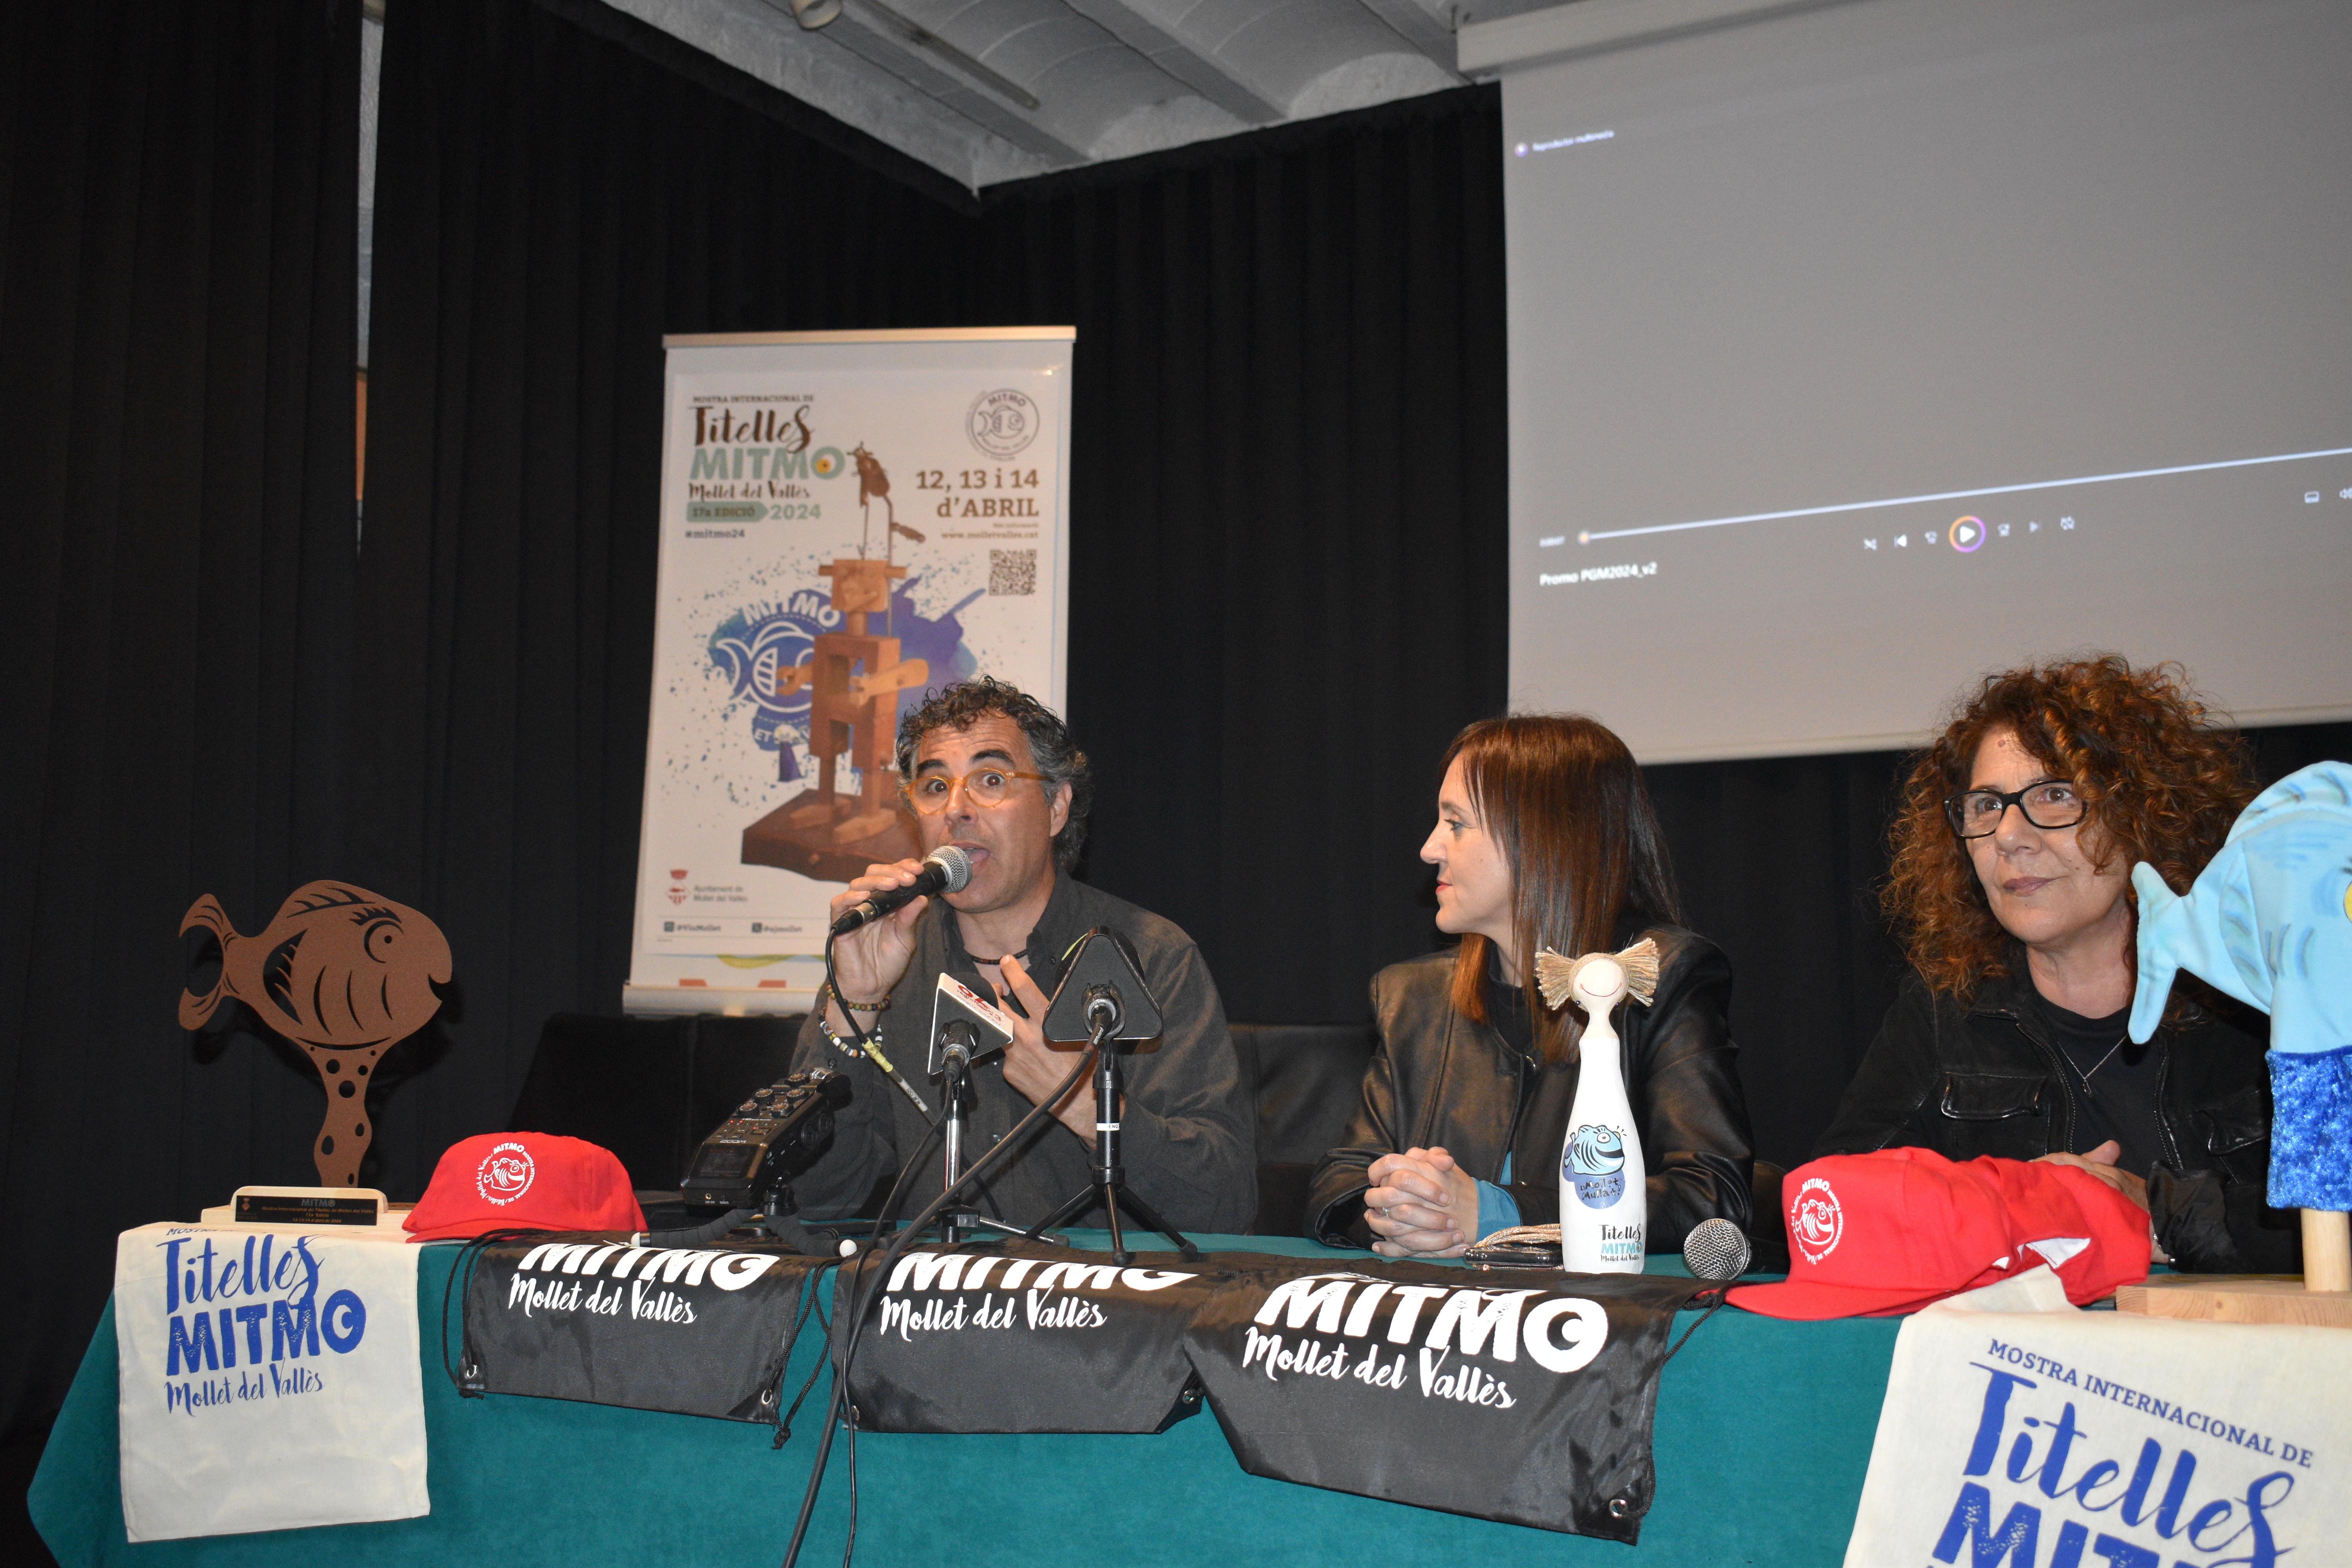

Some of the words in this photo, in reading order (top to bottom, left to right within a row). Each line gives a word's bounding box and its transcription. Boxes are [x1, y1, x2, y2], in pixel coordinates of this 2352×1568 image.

[988, 393, 1026, 407] MITMO
[690, 446, 846, 480] MITMO
[689, 483, 735, 502] Mollet
[740, 482, 762, 498] del
[768, 480, 810, 499] Vallès
[916, 470, 951, 493] 12,
[960, 470, 987, 489] 13
[995, 467, 1003, 489] i
[1011, 469, 1039, 488] 14
[769, 504, 821, 520] 2024
[936, 497, 1039, 517] d'ABRIL
[1539, 572, 1579, 586] Promo
[493, 1142, 524, 1154] MITMO
[522, 1151, 534, 1167] MOSTRA
[515, 1167, 535, 1199] INTERNACIONAL
[1582, 1184, 1621, 1200] Mullat!
[1585, 1177, 1619, 1190] Mollet
[1802, 1178, 1829, 1194] MITMO
[301, 1198, 336, 1207] MITMO
[1826, 1189, 1841, 1212] MOSTRA
[1599, 1223, 1642, 1243] Titelles
[1823, 1212, 1843, 1256] INTERNACIONAL
[1601, 1241, 1642, 1254] MITMO
[157, 1234, 328, 1315] Titelles
[508, 1272, 583, 1318] Mollet
[585, 1280, 624, 1316] del
[631, 1276, 698, 1324] Vallès
[880, 1294, 970, 1342] Mollet
[973, 1293, 1016, 1328] del
[1027, 1284, 1107, 1330] Vallès
[166, 1289, 367, 1376] MITMO
[1254, 1279, 1609, 1373] MITMO
[1242, 1326, 1350, 1381] Mollet
[1353, 1343, 1407, 1390] del
[1419, 1345, 1517, 1409] Vallès
[165, 1375, 235, 1417] Mollet
[238, 1371, 267, 1401] del
[269, 1357, 325, 1399] Vallès
[1987, 1338, 2078, 1387] MOSTRA
[2084, 1374, 2275, 1456] INTERNACIONAL
[2280, 1442, 2314, 1469] DE
[1962, 1361, 2296, 1568] Titelles
